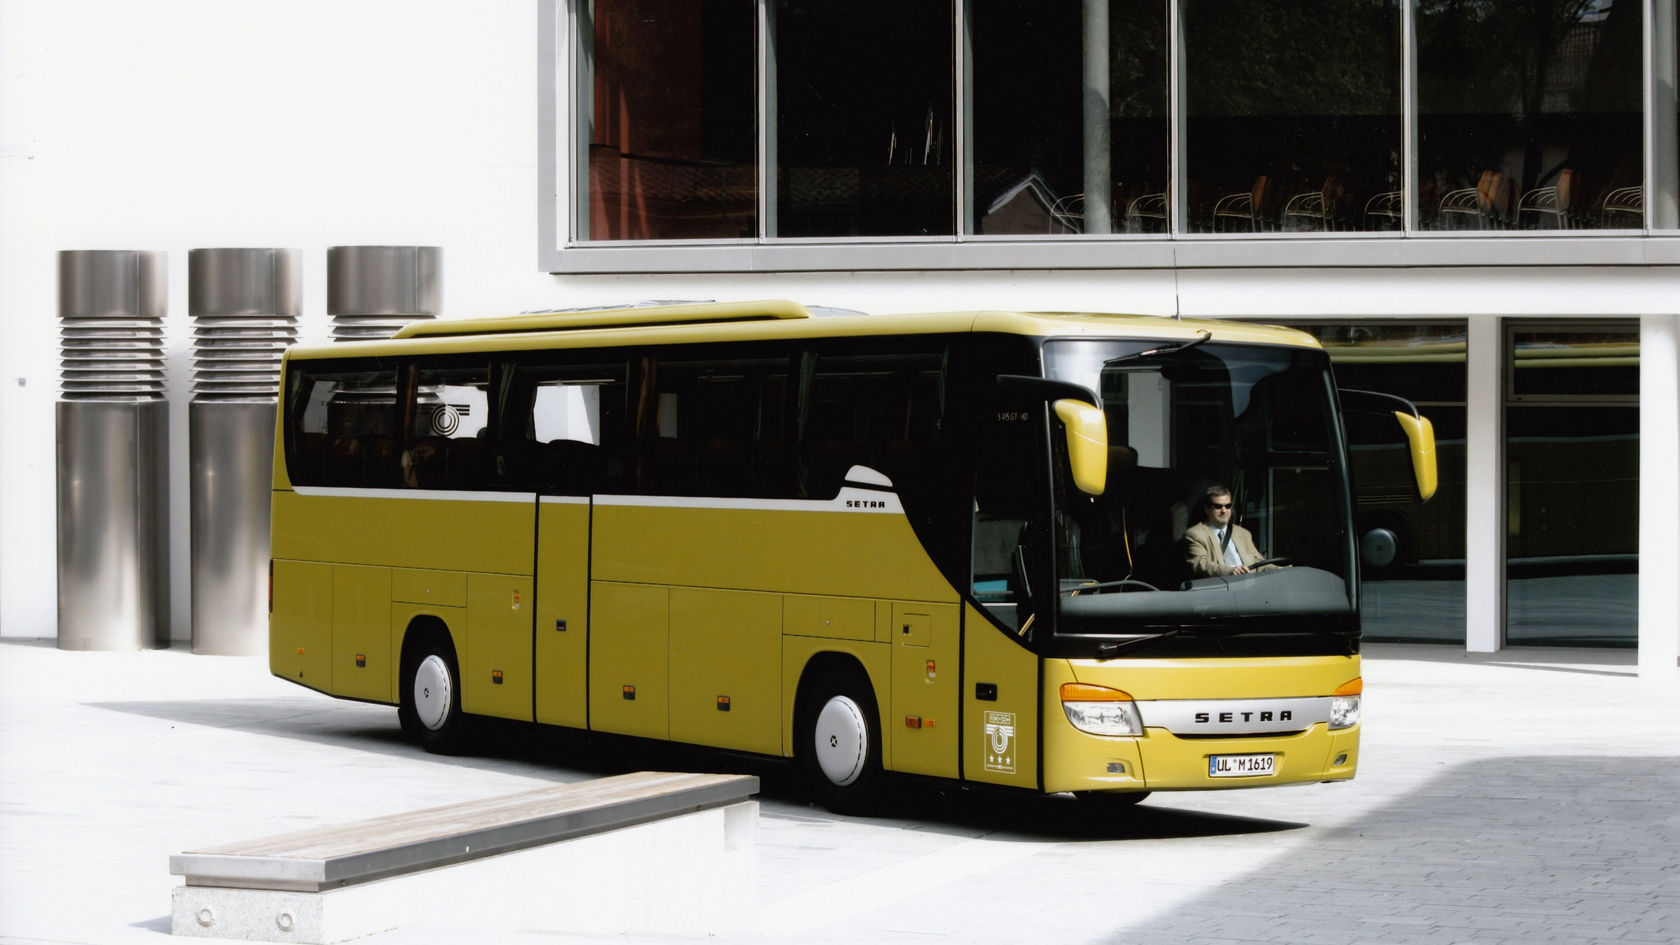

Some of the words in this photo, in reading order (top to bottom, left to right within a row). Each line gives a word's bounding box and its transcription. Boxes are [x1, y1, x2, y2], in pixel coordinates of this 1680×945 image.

[846, 500, 885, 509] SETRA
[1195, 710, 1292, 723] SETRA
[1217, 759, 1231, 772] UL
